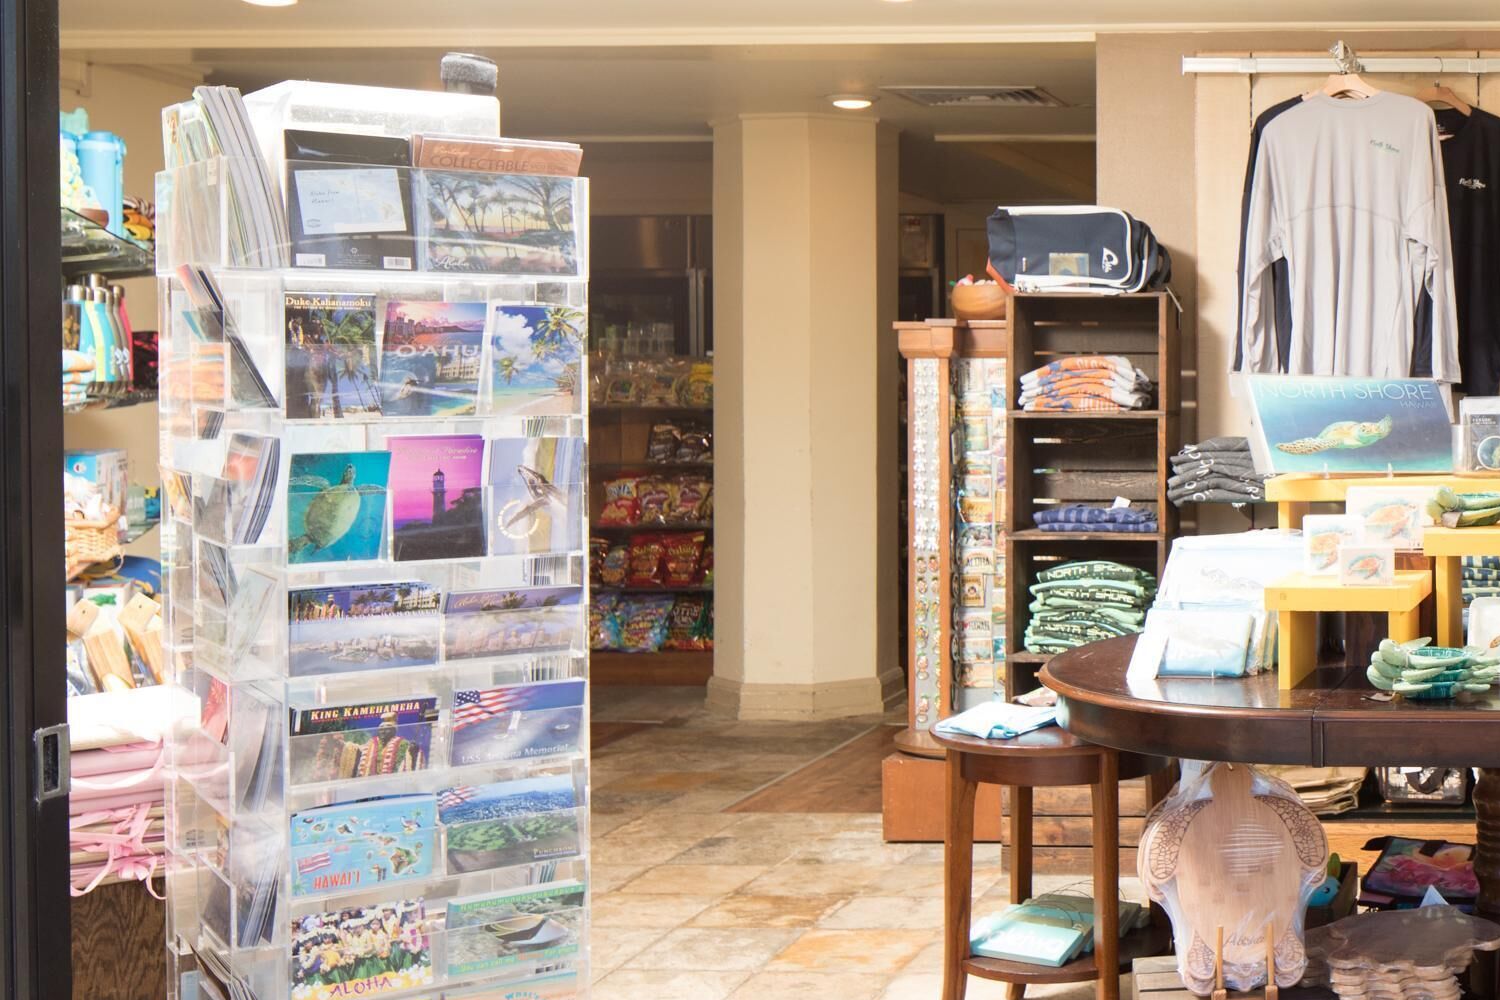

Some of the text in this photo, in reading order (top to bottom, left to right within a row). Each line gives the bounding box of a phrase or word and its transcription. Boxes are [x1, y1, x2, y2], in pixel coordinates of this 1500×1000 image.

[430, 155, 529, 173] COLLECTABLE
[285, 296, 312, 306] Duke
[313, 297, 372, 308] Kahanamoku
[396, 342, 480, 358] O'AHU
[1259, 382, 1433, 400] NORTH SHORE
[1046, 565, 1088, 580] NORTH
[310, 710, 339, 721] KING
[343, 702, 420, 717] KAMEHAMEHA
[461, 754, 481, 764] USS
[524, 744, 568, 758] Memorial
[314, 870, 360, 889] HAWAI'I
[328, 976, 392, 998] ALOHA
